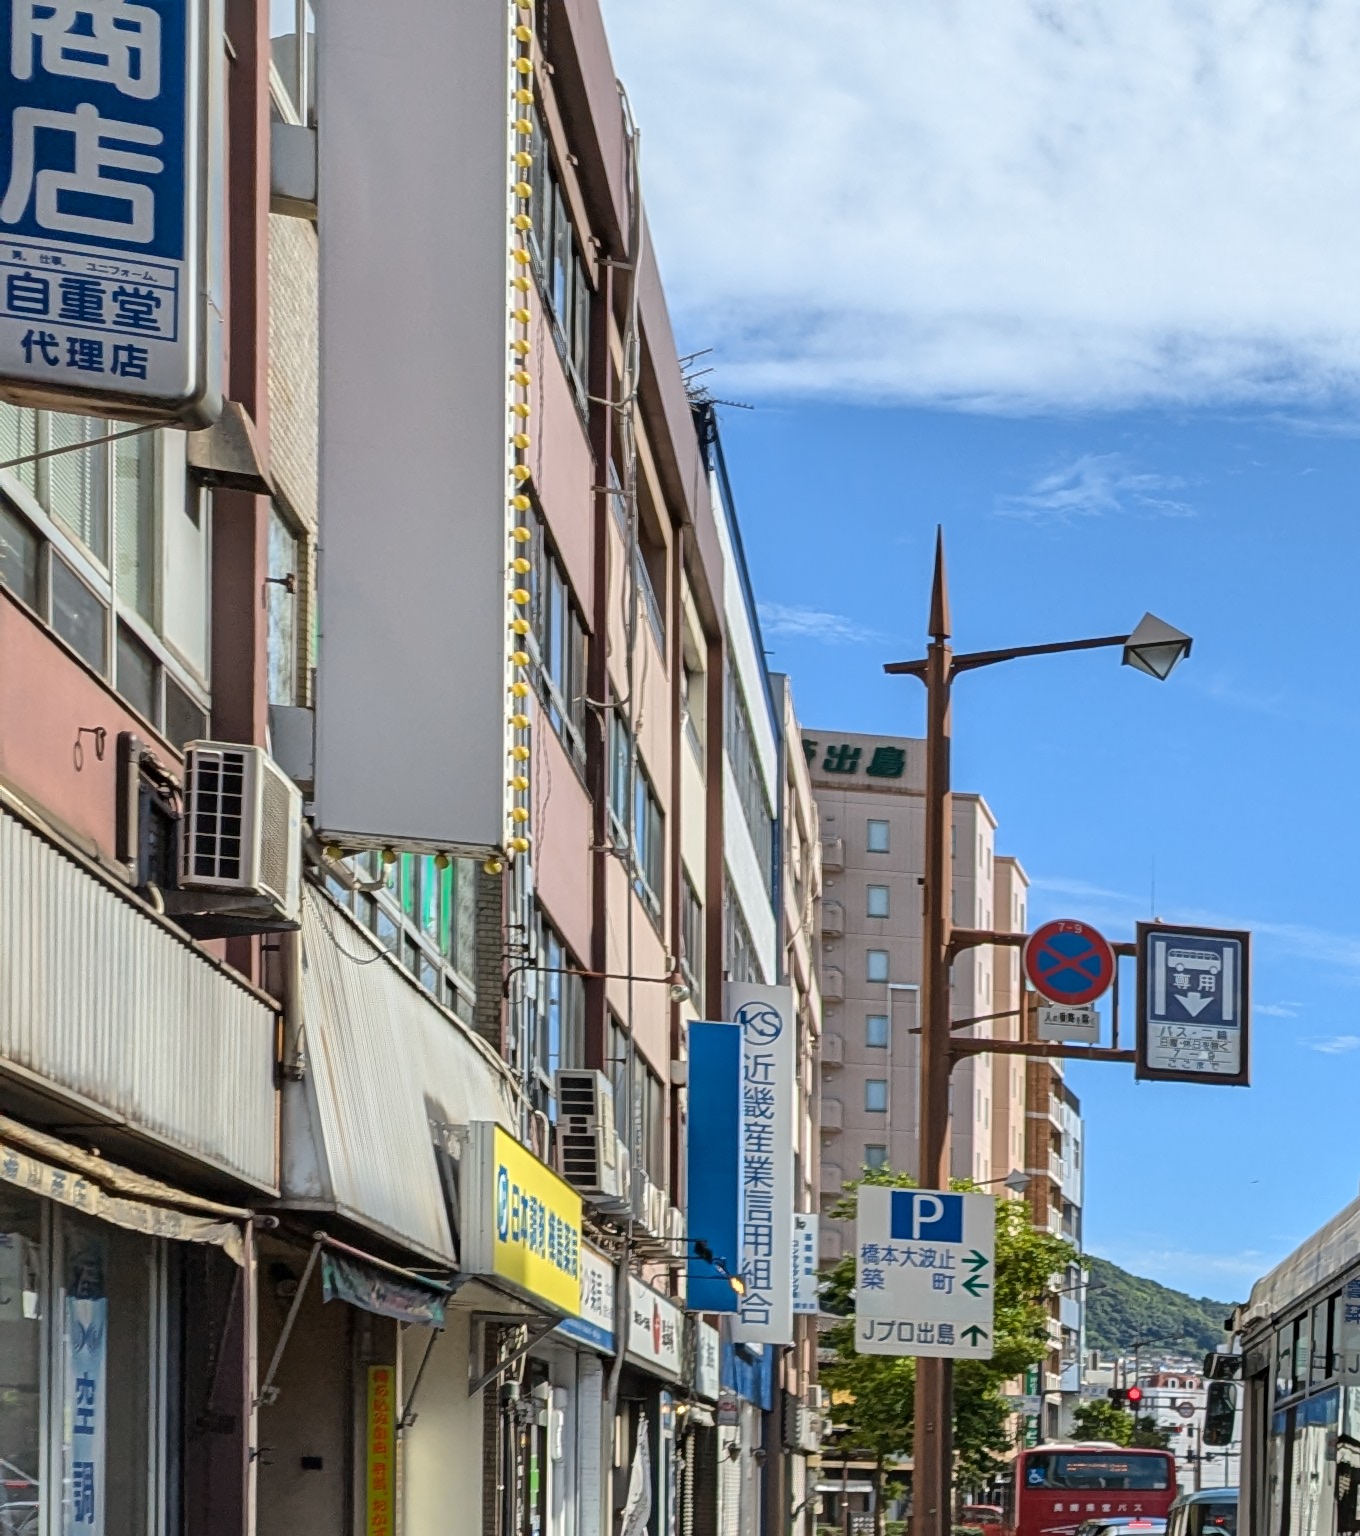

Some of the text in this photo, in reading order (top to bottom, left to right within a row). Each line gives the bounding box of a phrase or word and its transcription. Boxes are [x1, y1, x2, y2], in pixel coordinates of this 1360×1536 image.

[7, 271, 161, 331] 自重堂
[21, 329, 148, 380] 代理店
[1173, 972, 1216, 992] 専用
[740, 1010, 782, 1038] KS
[741, 1053, 776, 1325] 近畿産業信用組合
[912, 1194, 945, 1240] P
[861, 1243, 956, 1270] 橋本大波止
[862, 1319, 956, 1346] Jプロ出島
